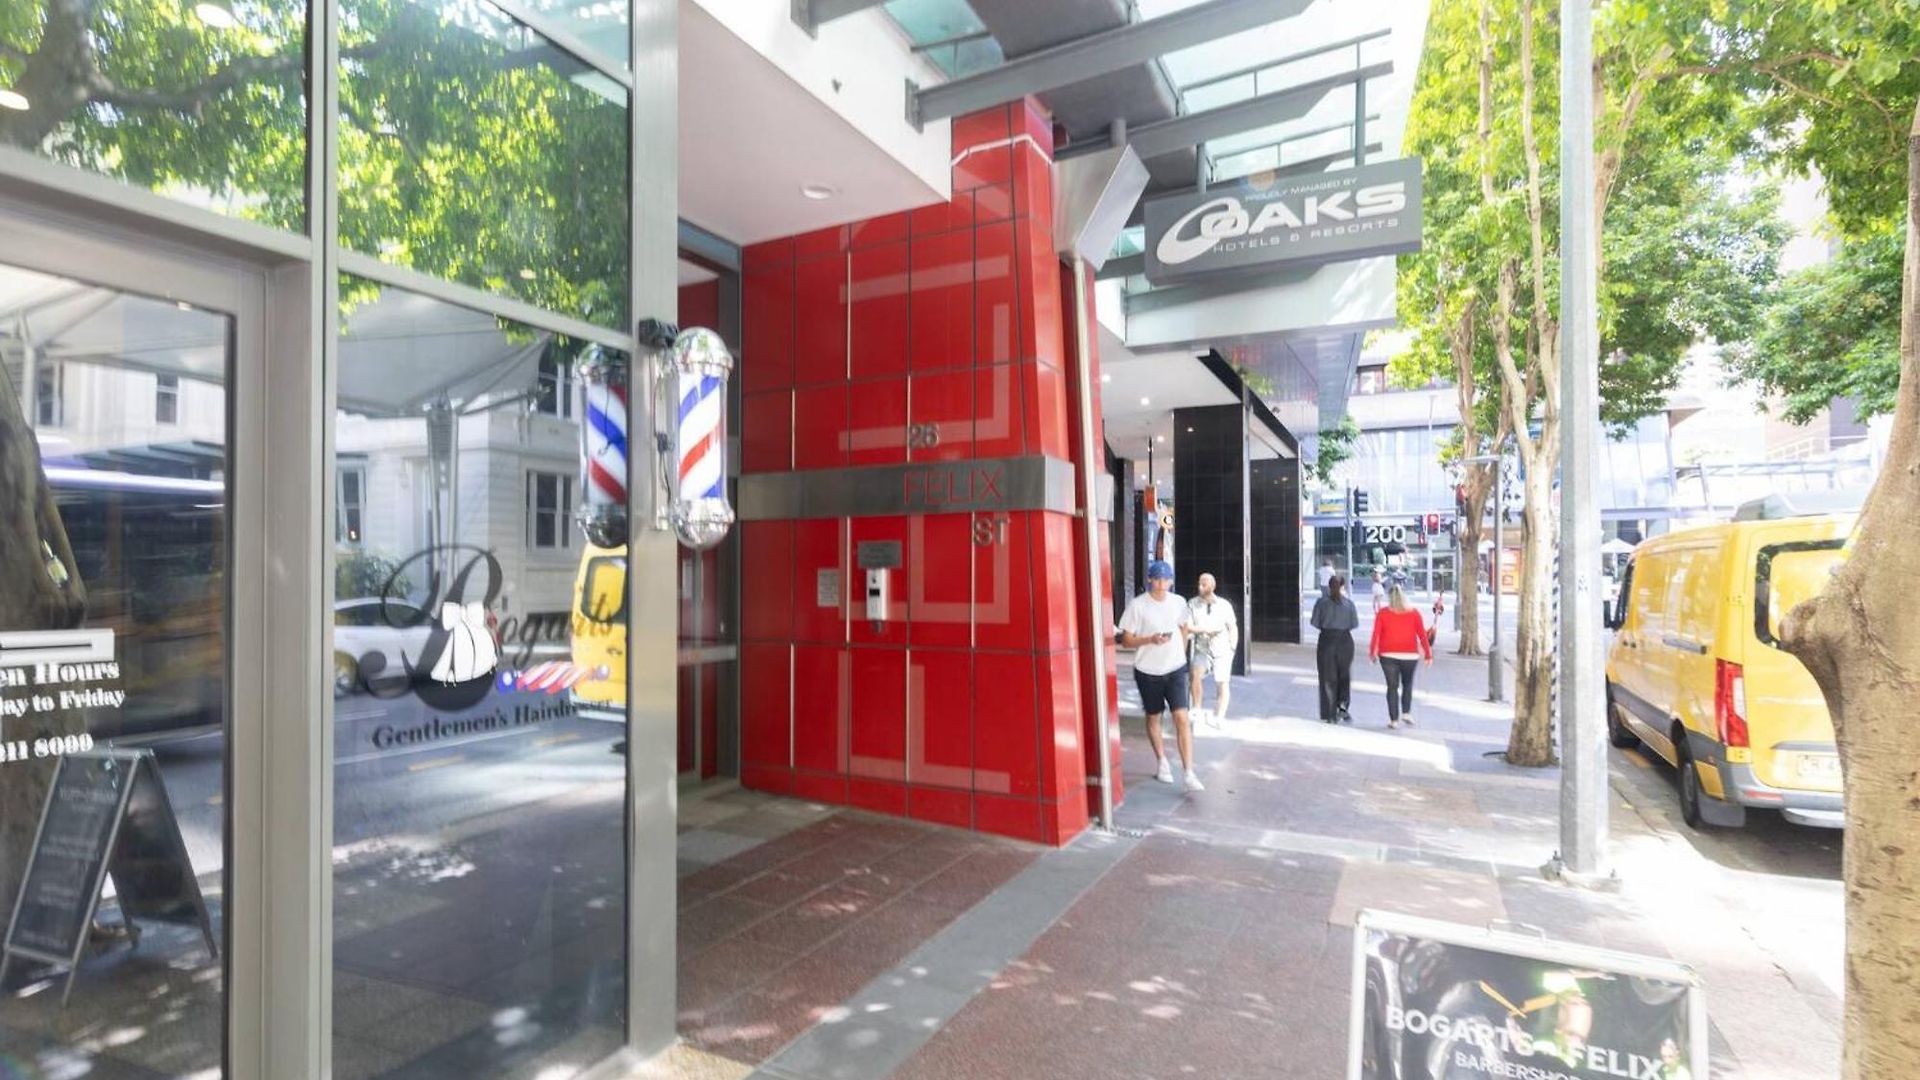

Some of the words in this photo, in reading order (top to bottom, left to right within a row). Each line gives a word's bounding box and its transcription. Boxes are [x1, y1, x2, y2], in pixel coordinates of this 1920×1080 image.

[1343, 177, 1358, 187] BY
[1157, 181, 1405, 264] OAKS
[1213, 236, 1280, 253] HOTELS
[1310, 218, 1399, 239] RESORTS
[907, 423, 940, 449] 26
[903, 466, 1004, 505] FELIX
[972, 517, 1010, 546] ST
[1366, 526, 1406, 544] 200
[34, 661, 120, 685] Hours
[32, 694, 55, 712] to
[60, 688, 125, 711] Friday
[371, 709, 508, 748] Gentlemen's
[34, 733, 94, 758] 8000
[1386, 1006, 1535, 1056] BOGARTS
[1568, 1041, 1664, 1080] FELIX
